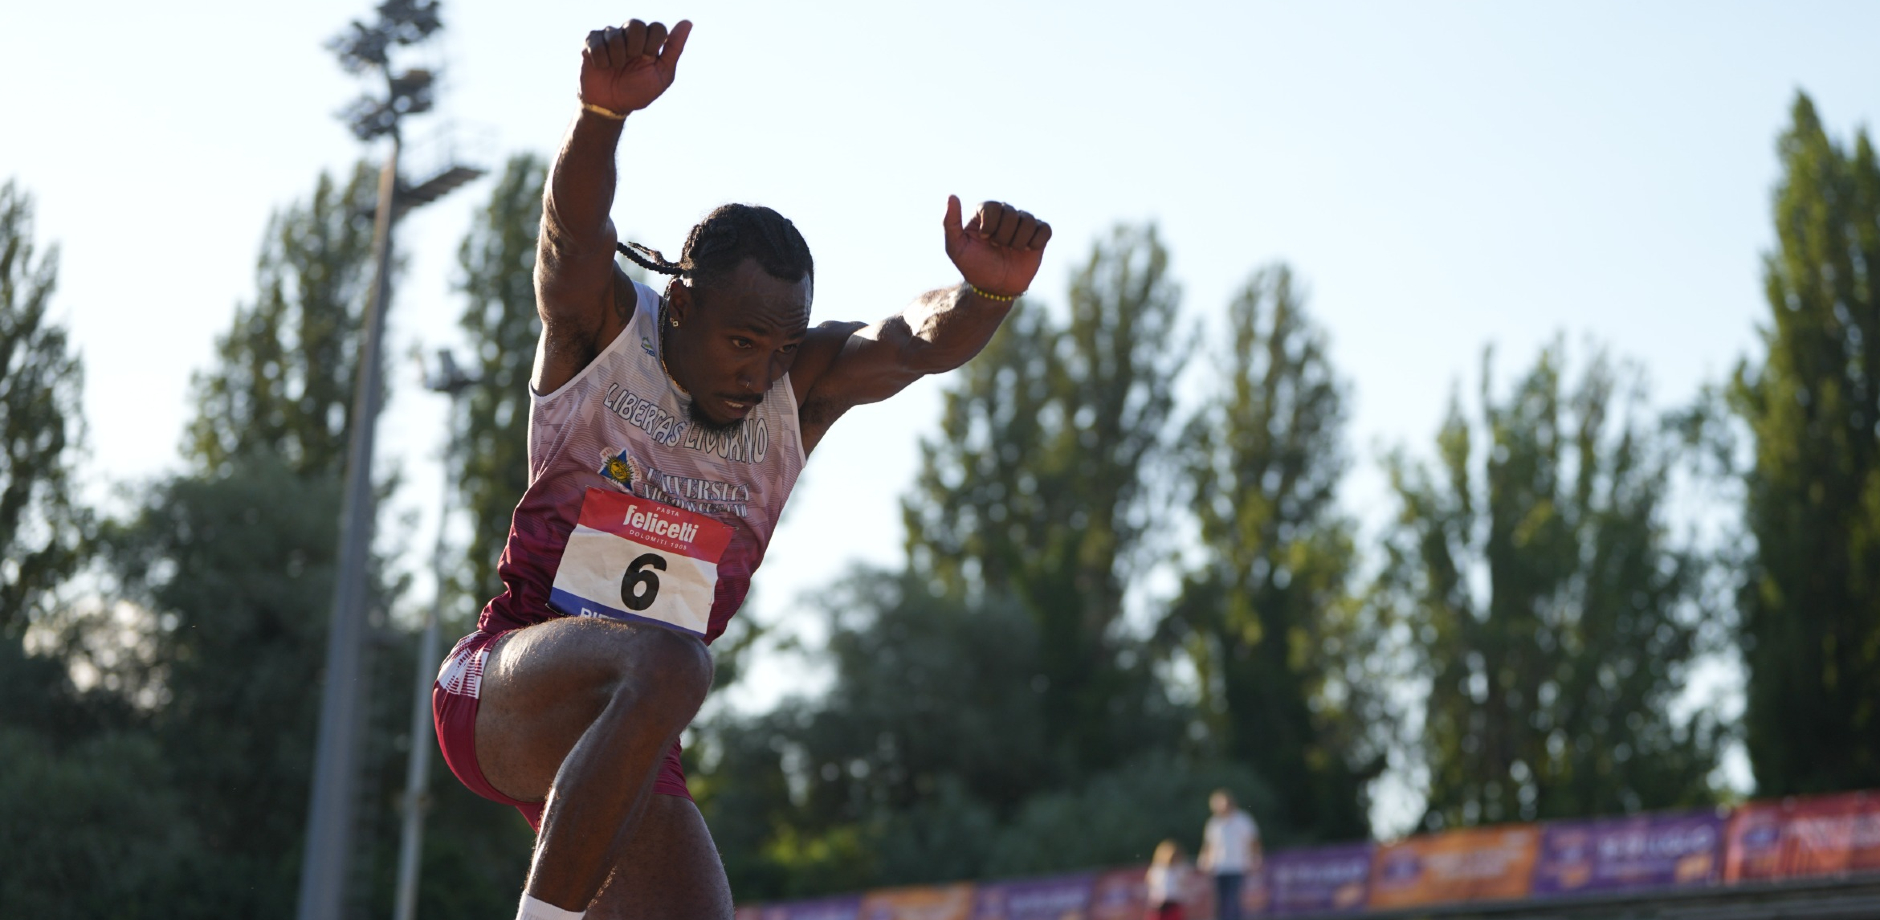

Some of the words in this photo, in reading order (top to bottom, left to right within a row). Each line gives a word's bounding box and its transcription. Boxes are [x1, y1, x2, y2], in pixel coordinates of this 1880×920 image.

[603, 383, 687, 448] LIBERTAS
[656, 506, 680, 517] PASTA
[629, 529, 668, 546] DOLOMITI
[670, 542, 687, 551] 1908
[621, 553, 667, 611] 6
